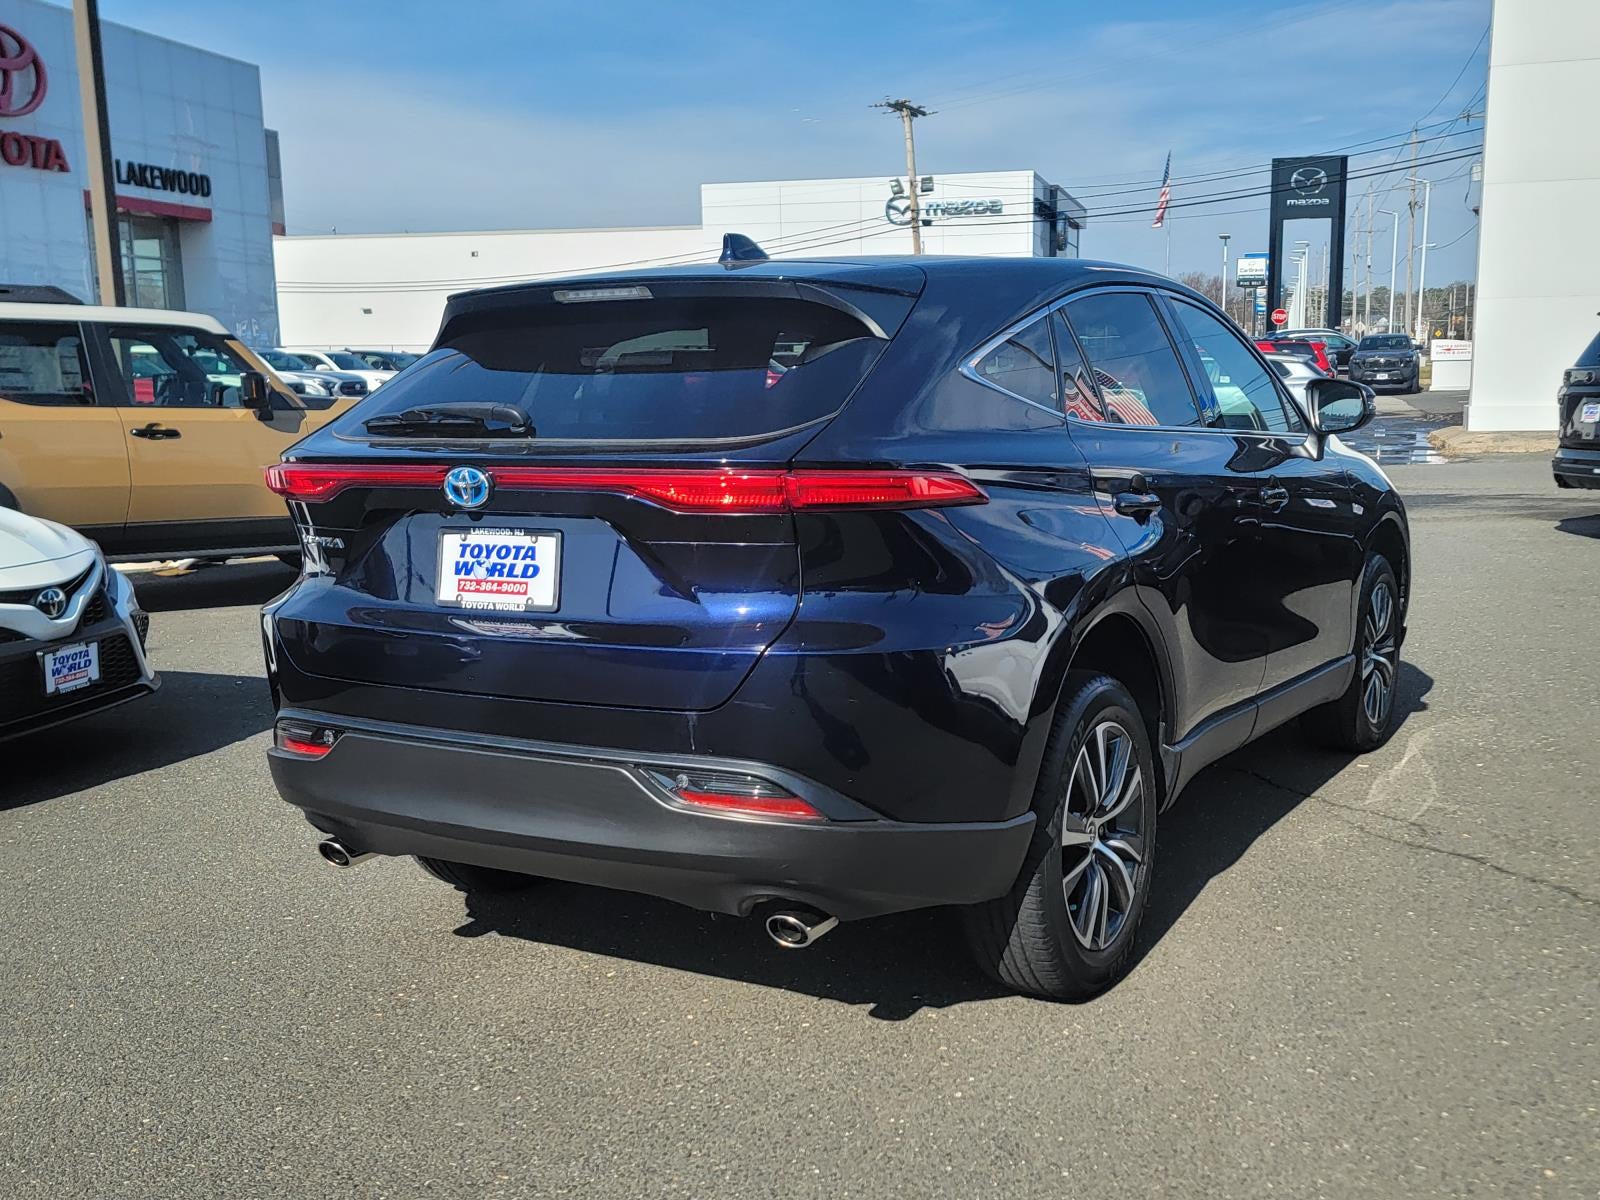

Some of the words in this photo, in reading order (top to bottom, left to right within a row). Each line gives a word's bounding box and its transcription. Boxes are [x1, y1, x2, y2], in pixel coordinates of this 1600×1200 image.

[0, 131, 71, 172] OTA
[115, 158, 211, 197] LAKEWOOD
[925, 199, 1003, 217] mazda
[1286, 198, 1330, 207] mazda
[470, 527, 513, 536] LAKEWOOD,
[459, 543, 537, 561] TOYOTA
[454, 560, 540, 579] WORLD
[459, 581, 527, 593] 732-364-9000
[461, 601, 494, 610] TOYOTA
[495, 602, 526, 612] WORLD
[52, 649, 90, 667] TOYOTA
[51, 659, 92, 677] WORLD
